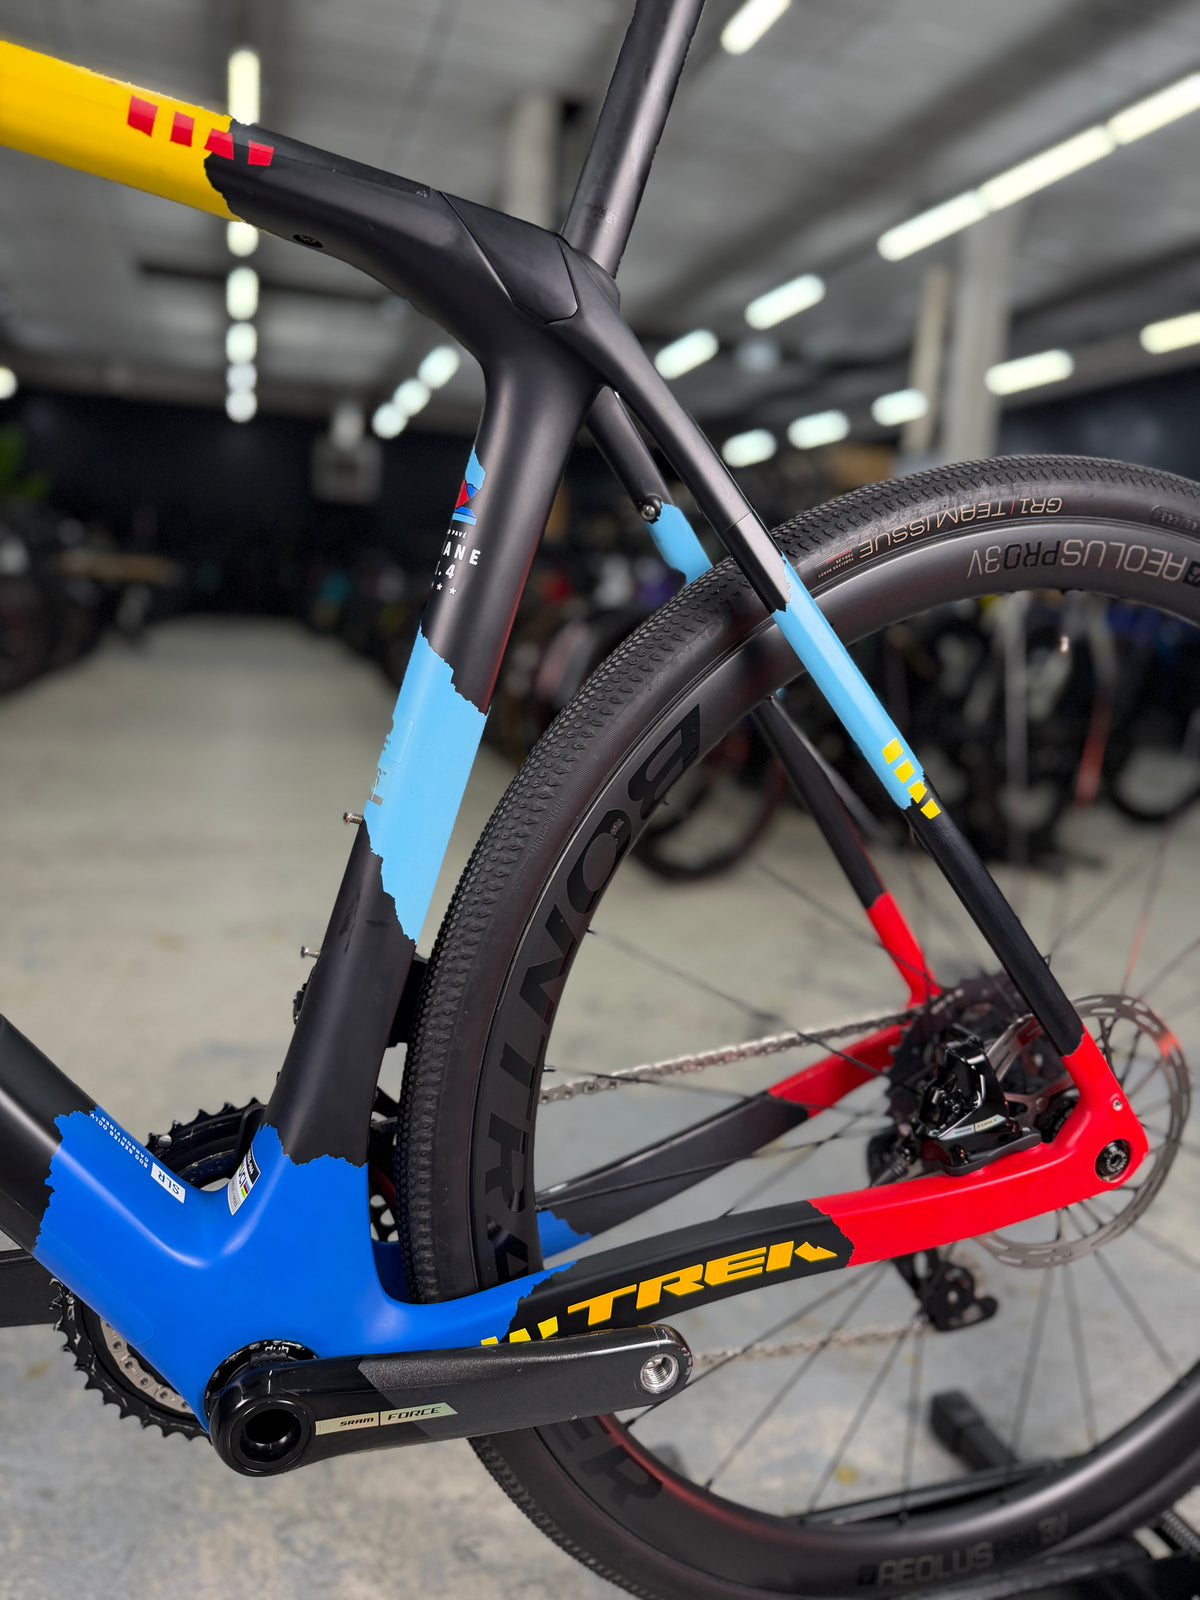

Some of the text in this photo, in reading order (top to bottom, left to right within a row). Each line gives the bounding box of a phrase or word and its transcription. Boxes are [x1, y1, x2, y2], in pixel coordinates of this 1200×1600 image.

[936, 502, 1007, 529] TEAM
[1020, 497, 1063, 514] GR1
[857, 515, 930, 559] ISSUE
[157, 1170, 181, 1196] SLR
[566, 1239, 839, 1327] TREK
[339, 1405, 442, 1427] SRAM FORCE
